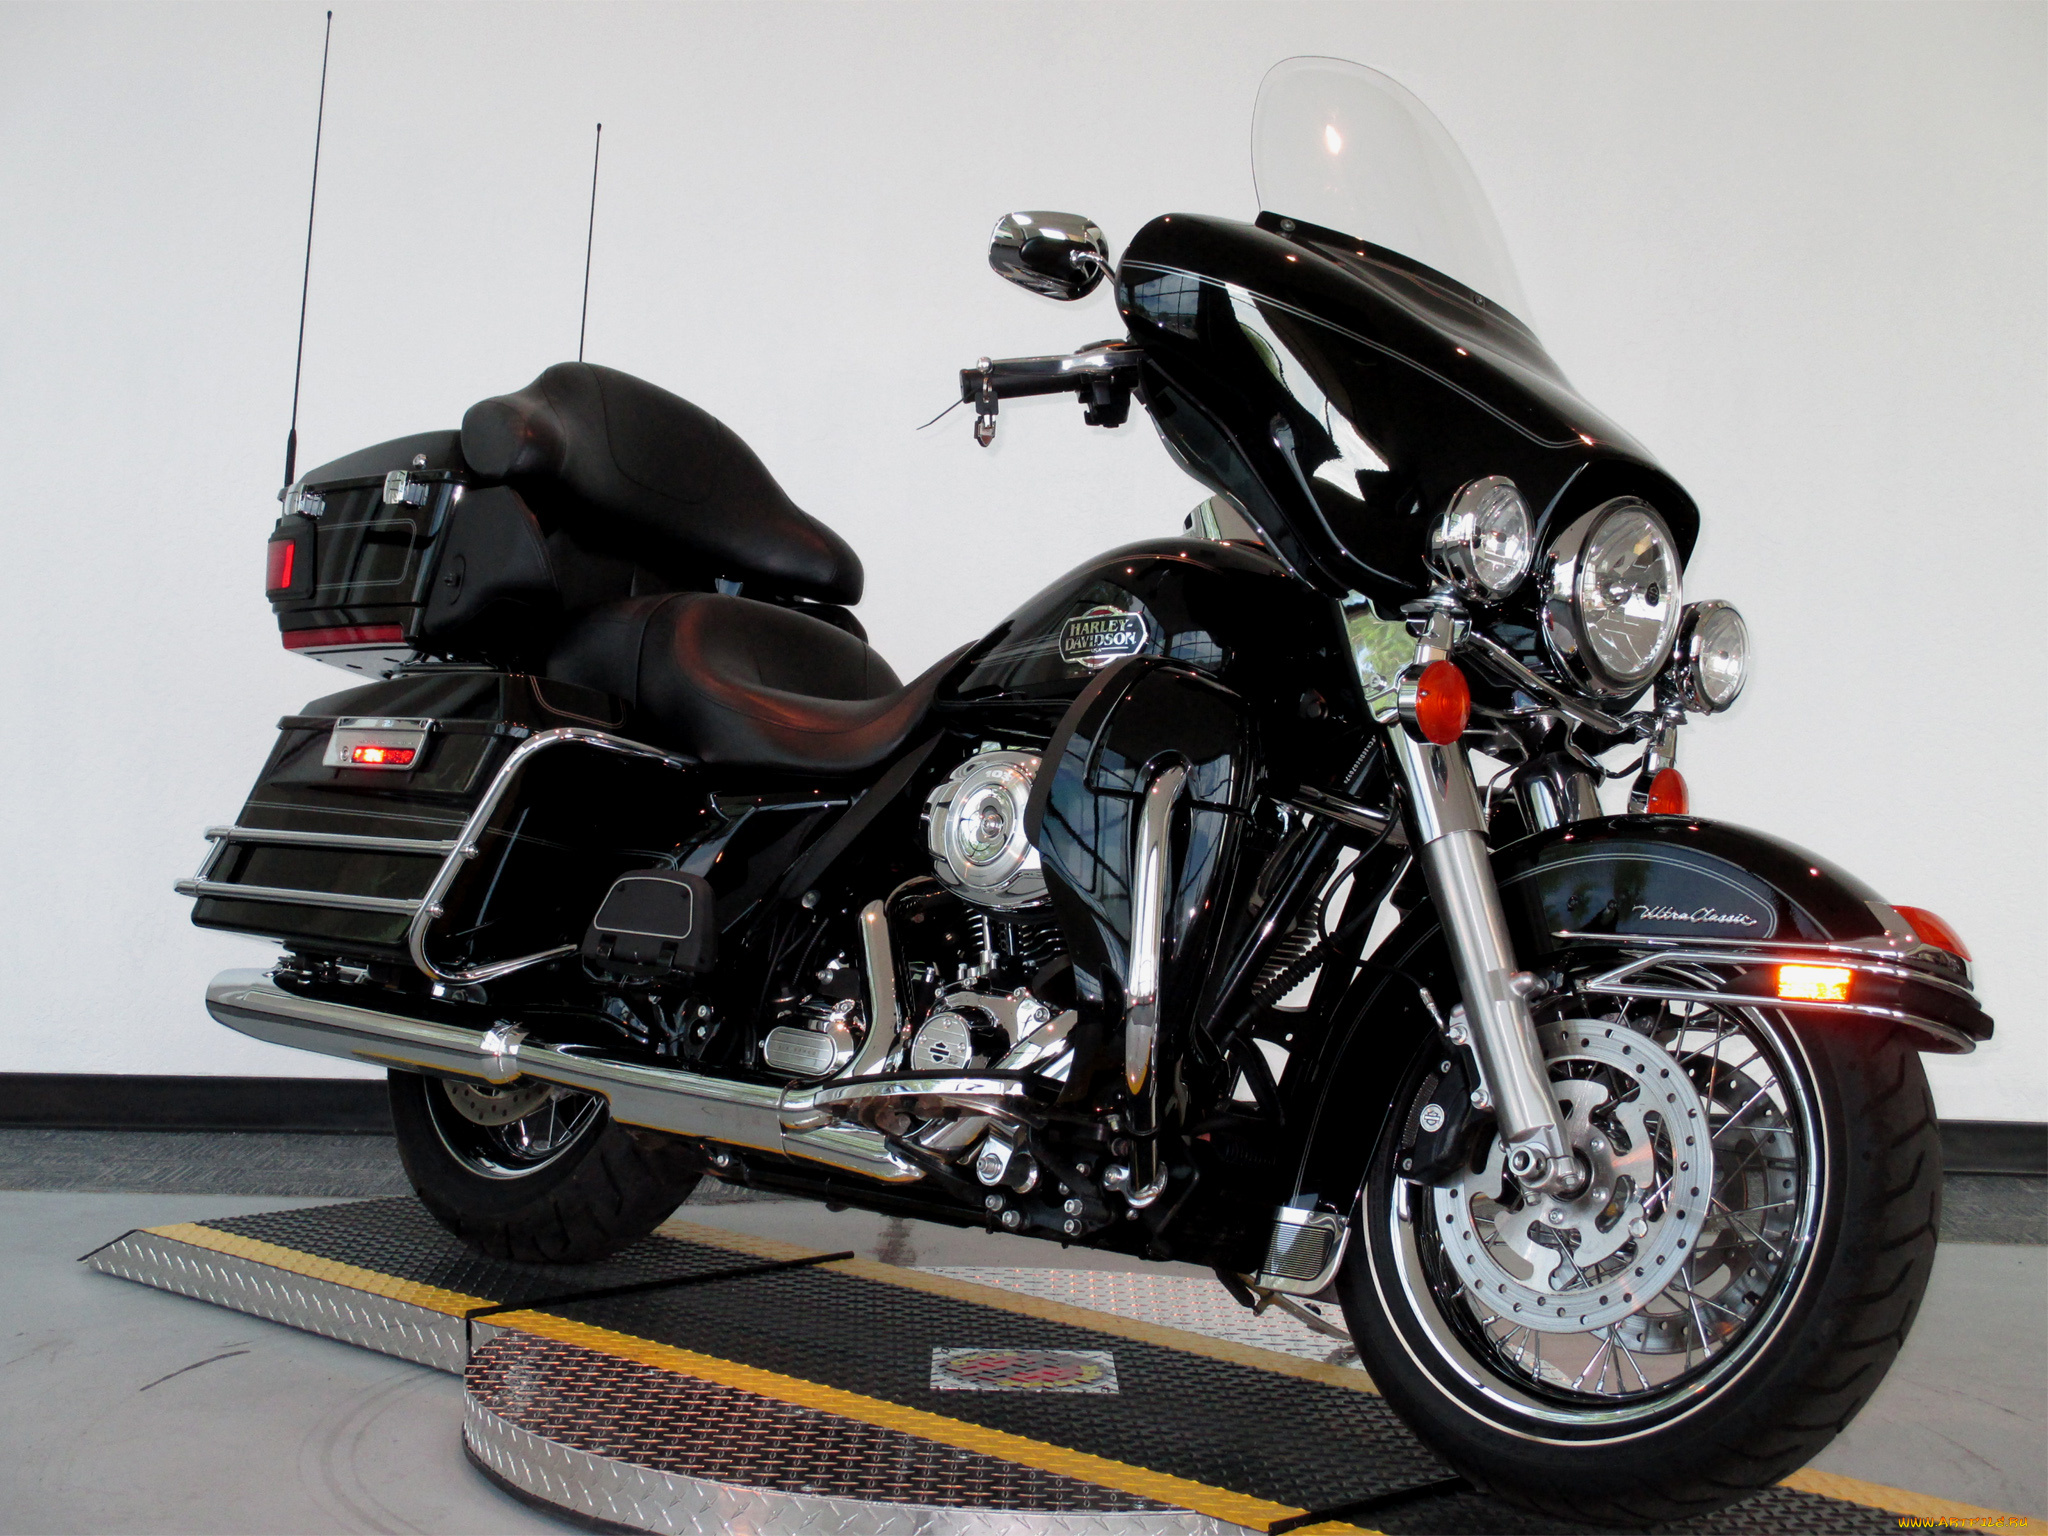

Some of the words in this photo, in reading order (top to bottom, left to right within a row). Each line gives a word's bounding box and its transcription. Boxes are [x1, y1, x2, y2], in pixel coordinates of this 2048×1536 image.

[1070, 618, 1133, 637] HARLEY-
[1065, 631, 1137, 651] DAVIDSON
[1632, 904, 1691, 922] Ultra
[1690, 906, 1758, 926] Classic
